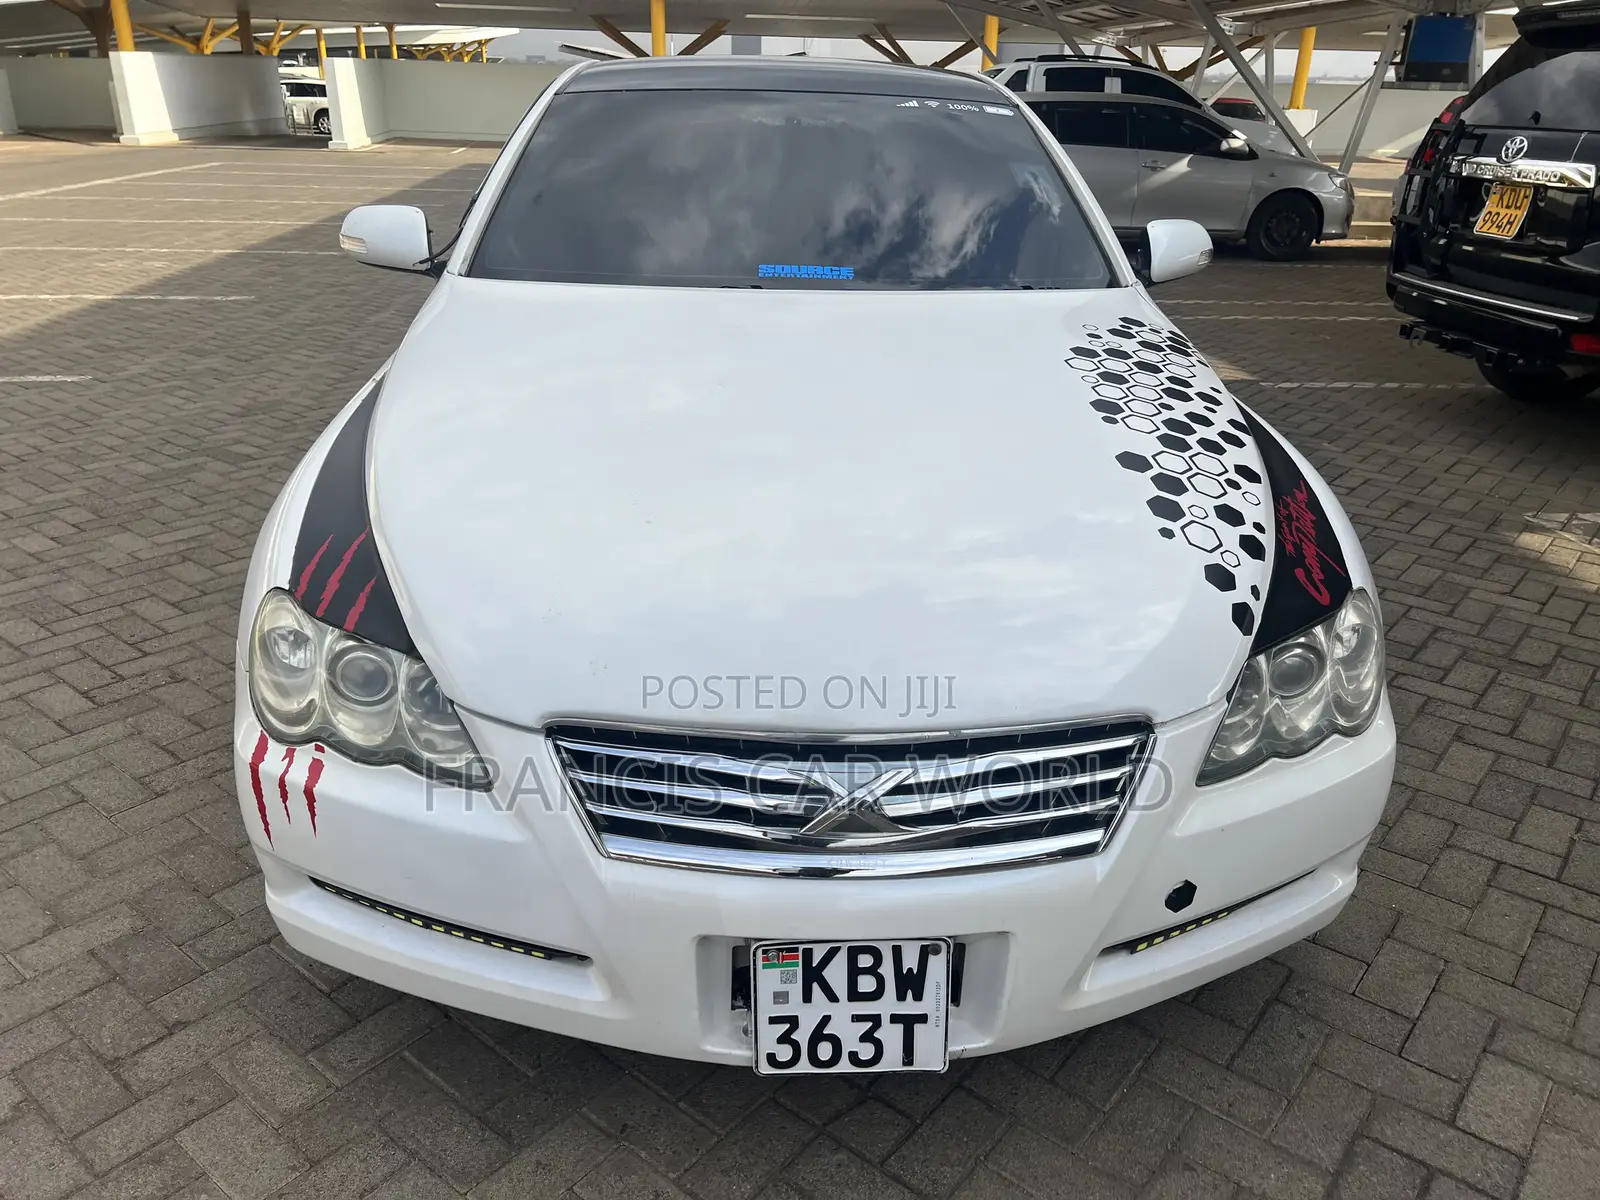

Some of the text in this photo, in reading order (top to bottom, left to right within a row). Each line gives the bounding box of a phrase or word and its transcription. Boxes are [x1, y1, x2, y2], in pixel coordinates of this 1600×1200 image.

[947, 103, 979, 112] 100%
[1477, 163, 1518, 178] CRUISER
[1518, 168, 1560, 182] PRADO
[1496, 187, 1527, 211] KDU
[1479, 210, 1518, 234] 994H
[758, 264, 854, 276] SOURCE
[758, 272, 854, 280] ENTERTAINMENT
[802, 943, 931, 1004] KBW
[766, 1012, 928, 1069] 363T
